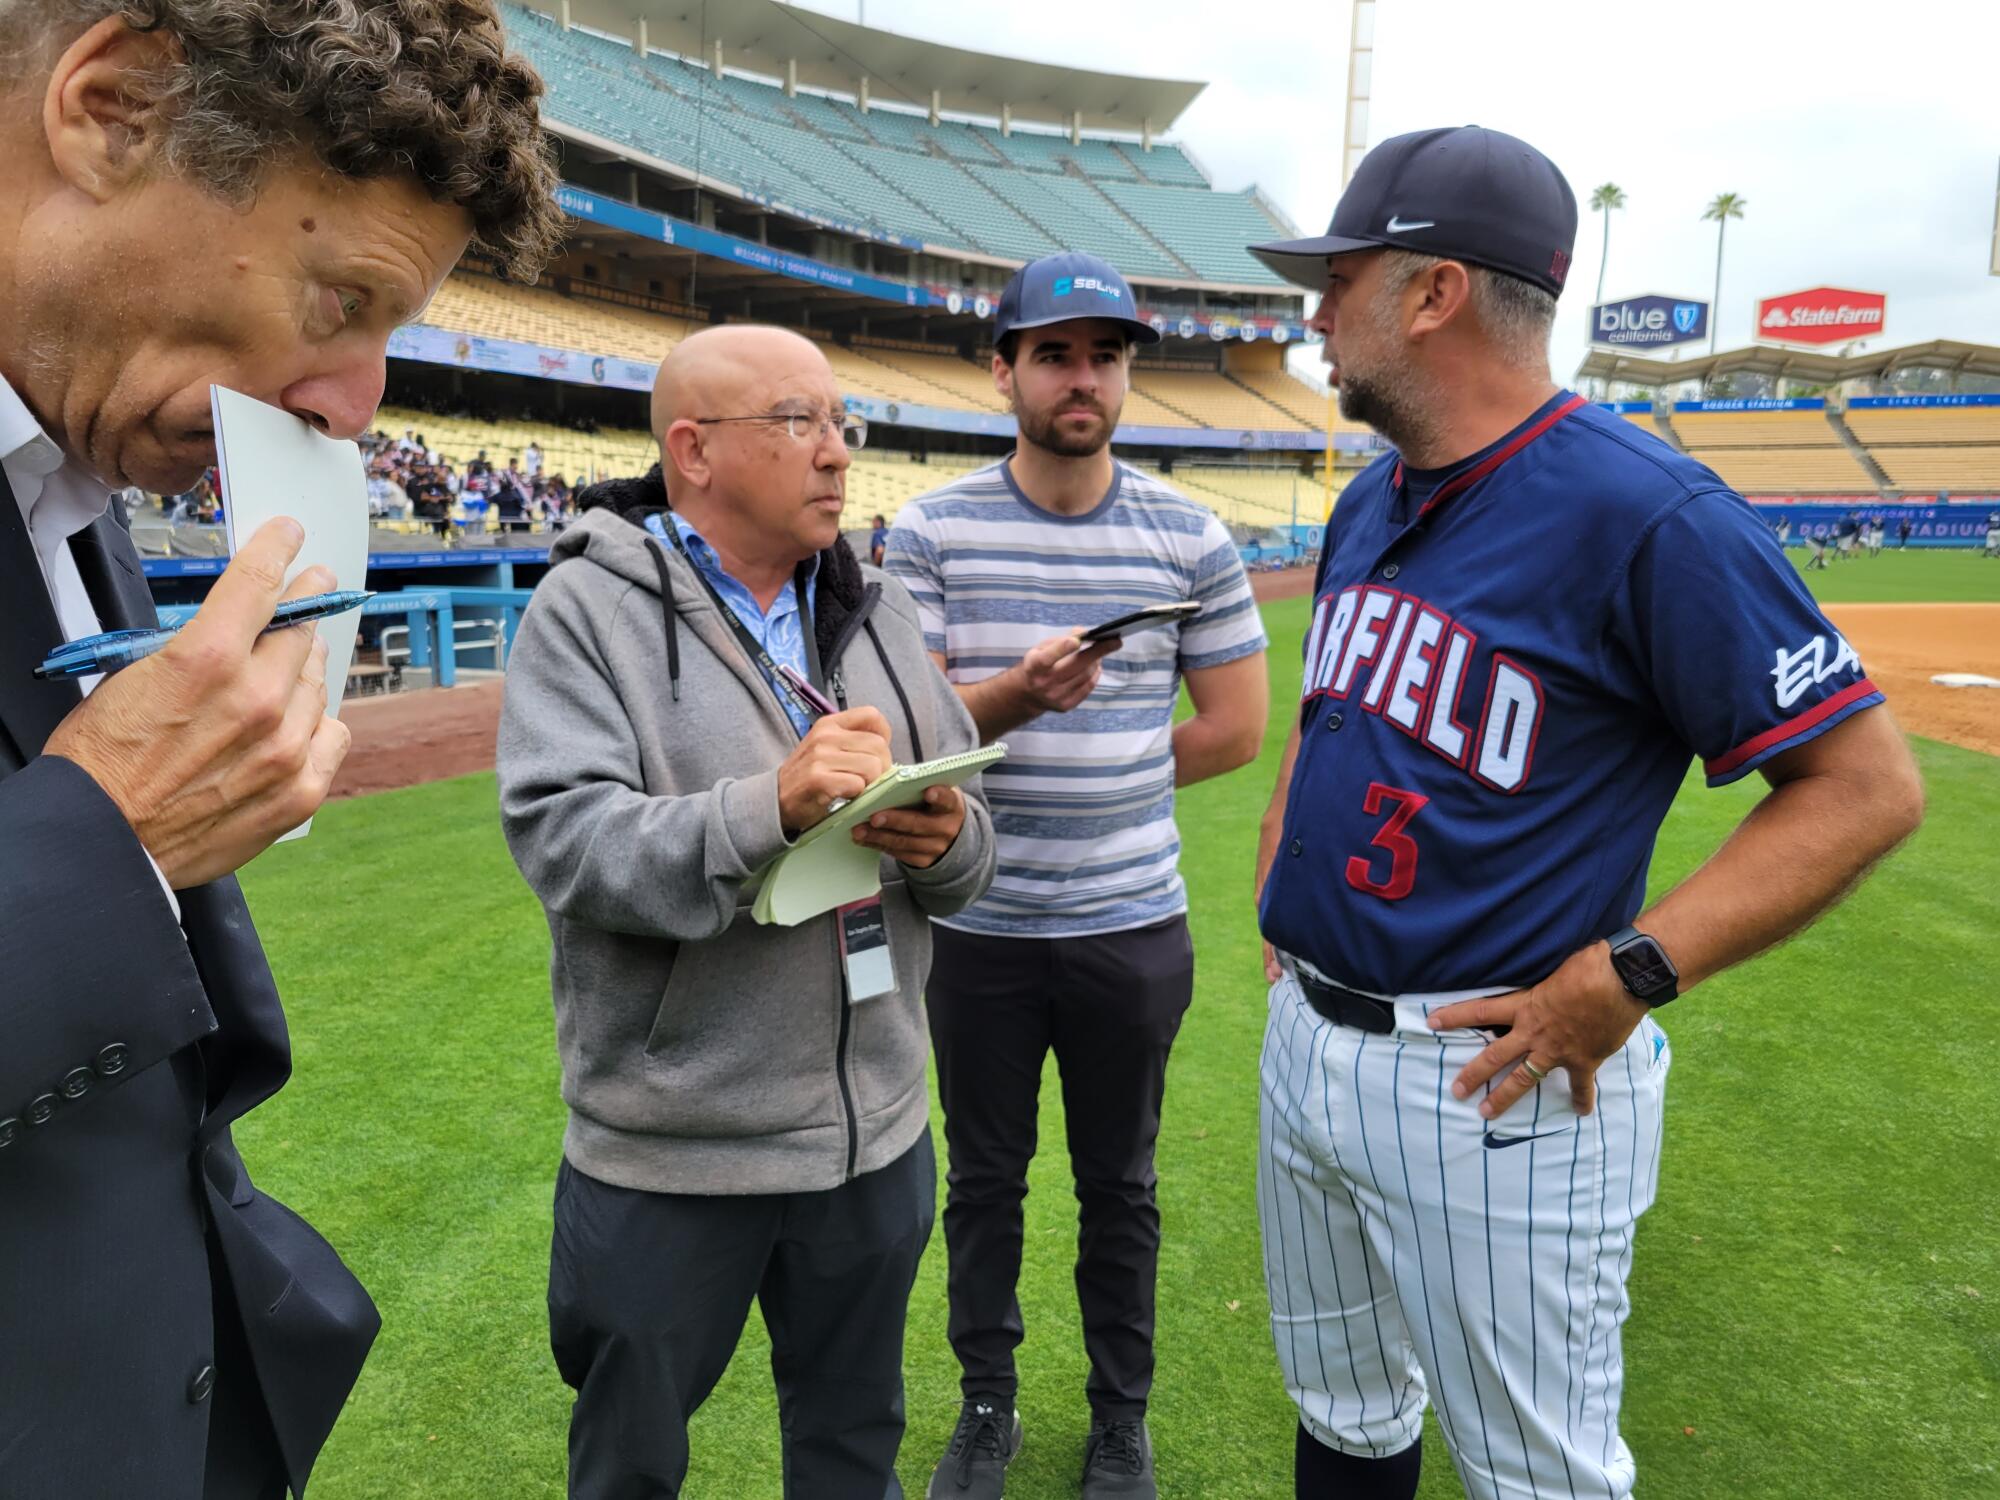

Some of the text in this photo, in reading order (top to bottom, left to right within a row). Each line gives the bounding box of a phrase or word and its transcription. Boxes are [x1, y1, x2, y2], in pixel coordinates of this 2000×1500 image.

[1600, 304, 1668, 331] blue
[1608, 329, 1674, 344] california
[1747, 398, 1795, 408] STADIUM
[382, 600, 420, 610] AMERICA
[1345, 782, 1430, 899] 3
